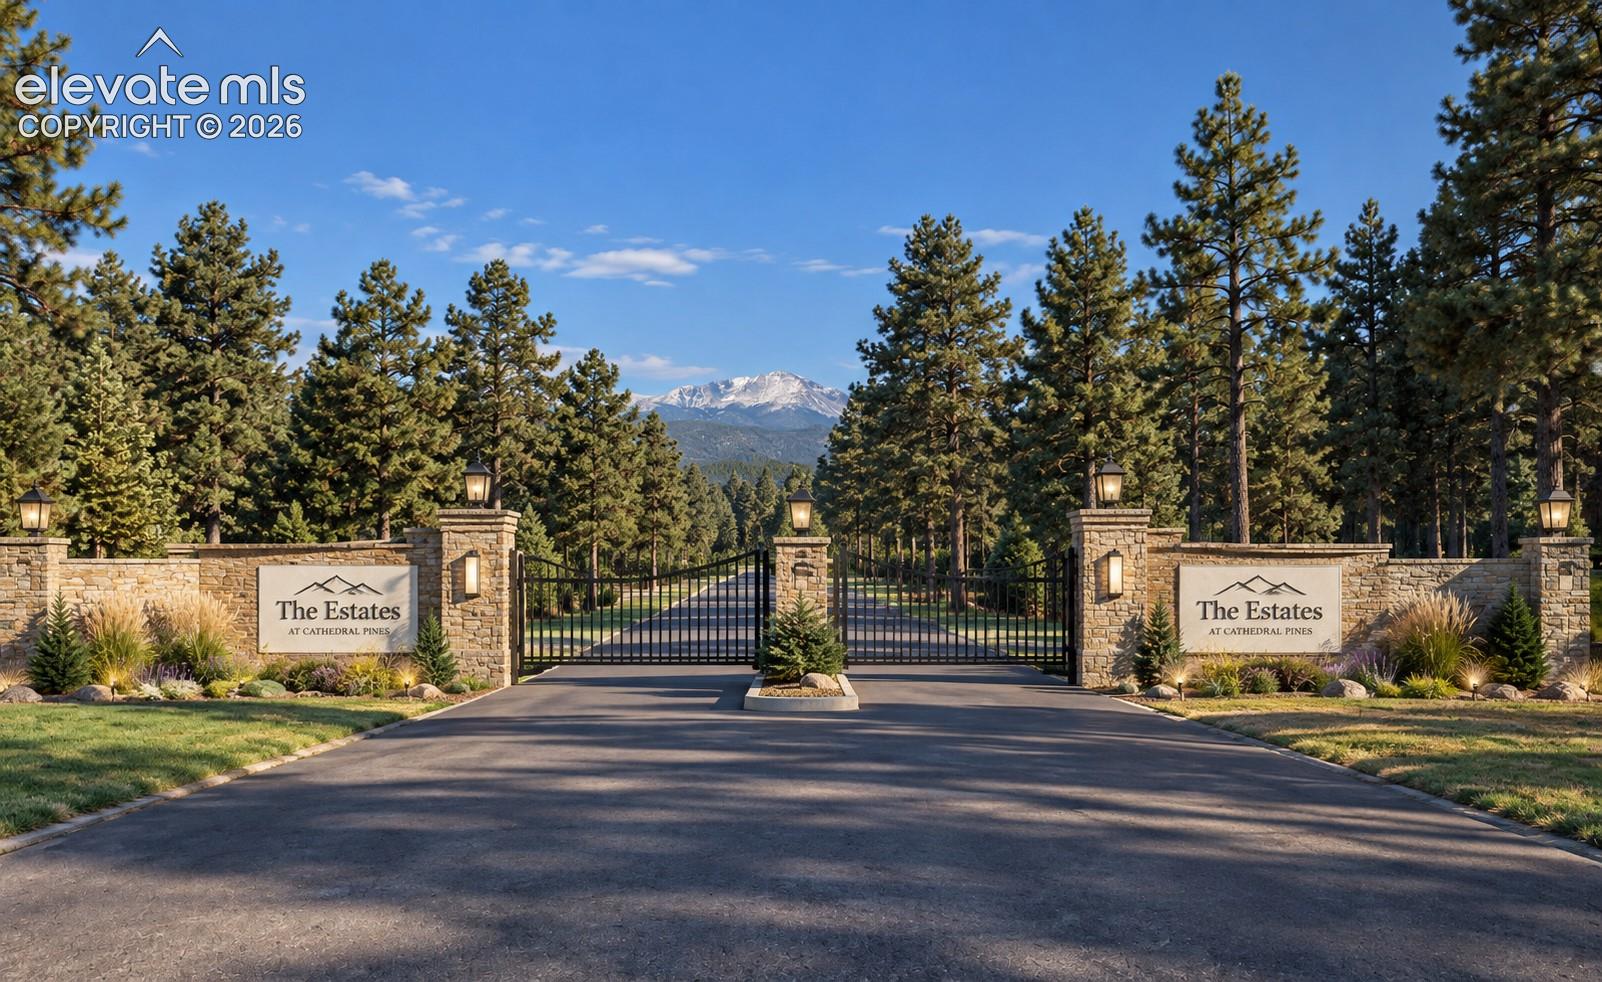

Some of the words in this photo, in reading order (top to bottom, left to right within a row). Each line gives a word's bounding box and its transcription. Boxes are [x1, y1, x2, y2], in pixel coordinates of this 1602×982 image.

[275, 600, 318, 620] The
[324, 600, 401, 620] Estates
[1196, 600, 1240, 620] The
[1245, 600, 1323, 620] Estates
[288, 627, 301, 636] AT
[303, 627, 360, 636] CATHEDRAL
[363, 627, 390, 636] PINES
[1208, 627, 1221, 636] AT
[1223, 627, 1282, 636] CATHEDRAL
[1285, 627, 1313, 636] PINES
